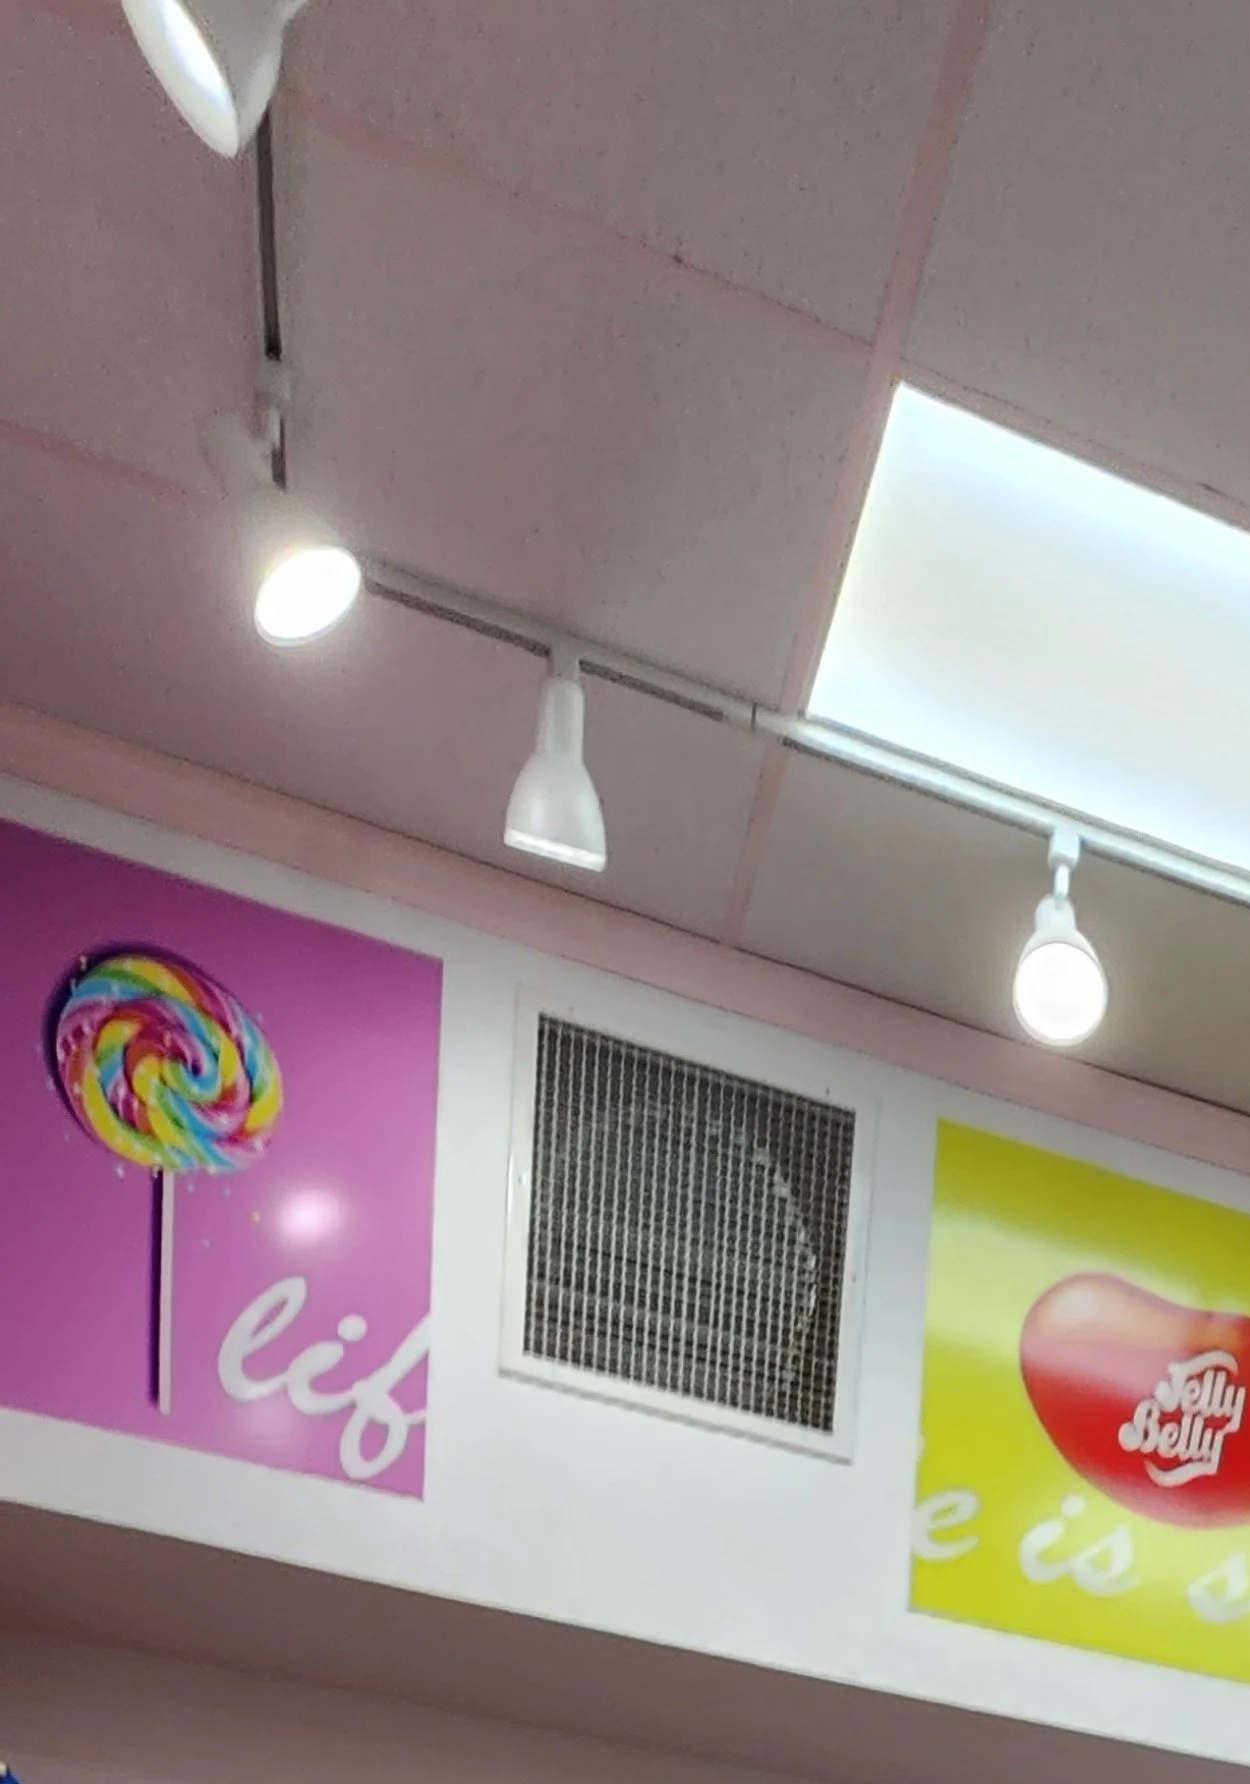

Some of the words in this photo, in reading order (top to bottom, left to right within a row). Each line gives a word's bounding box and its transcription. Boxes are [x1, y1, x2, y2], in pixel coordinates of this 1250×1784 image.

[1155, 1350, 1246, 1434] Jelly
[1118, 1399, 1228, 1487] Belly
[1019, 1495, 1139, 1597] is
